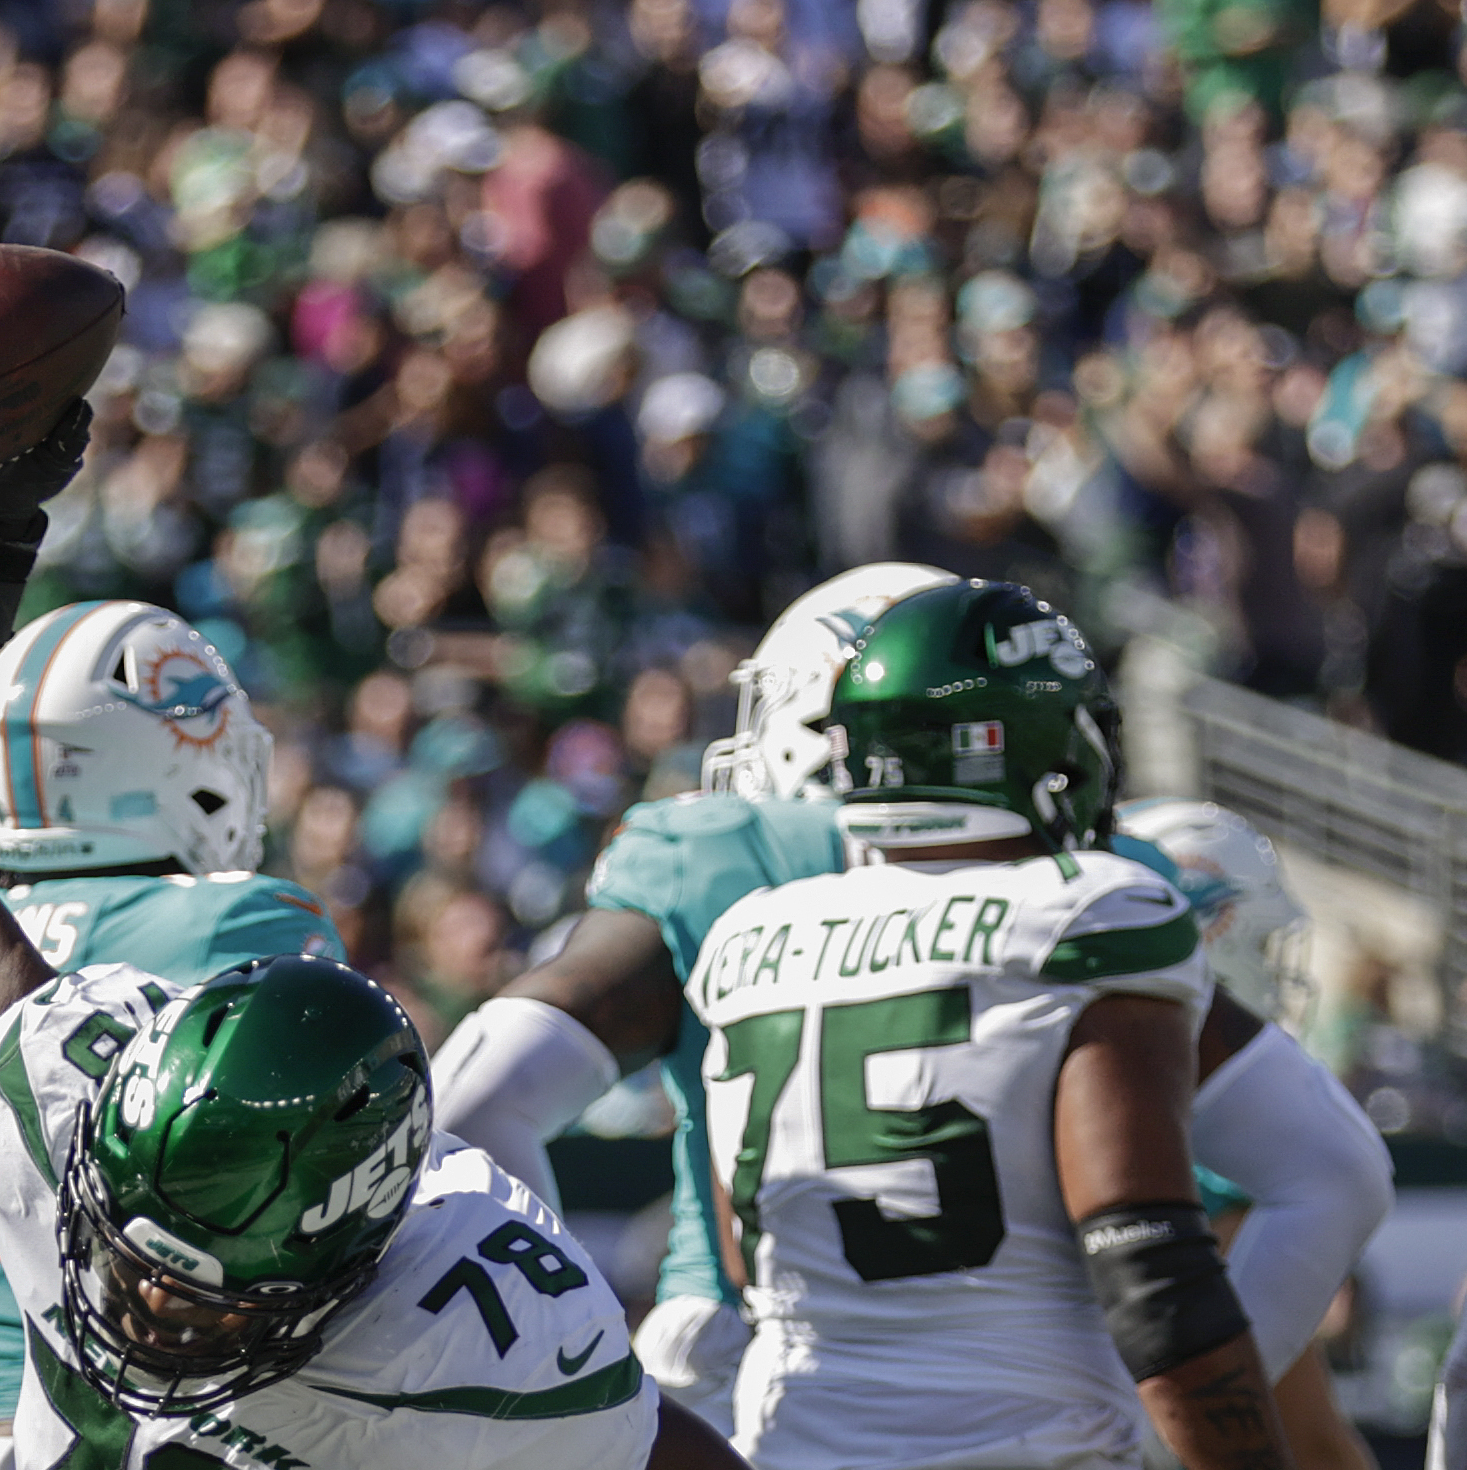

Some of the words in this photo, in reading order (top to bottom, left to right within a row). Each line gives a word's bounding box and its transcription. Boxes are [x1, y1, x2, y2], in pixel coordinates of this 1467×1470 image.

[864, 755, 905, 789] 75
[300, 1084, 428, 1233] JETS
[710, 986, 1009, 1285] 75
[416, 1219, 590, 1360] 78
